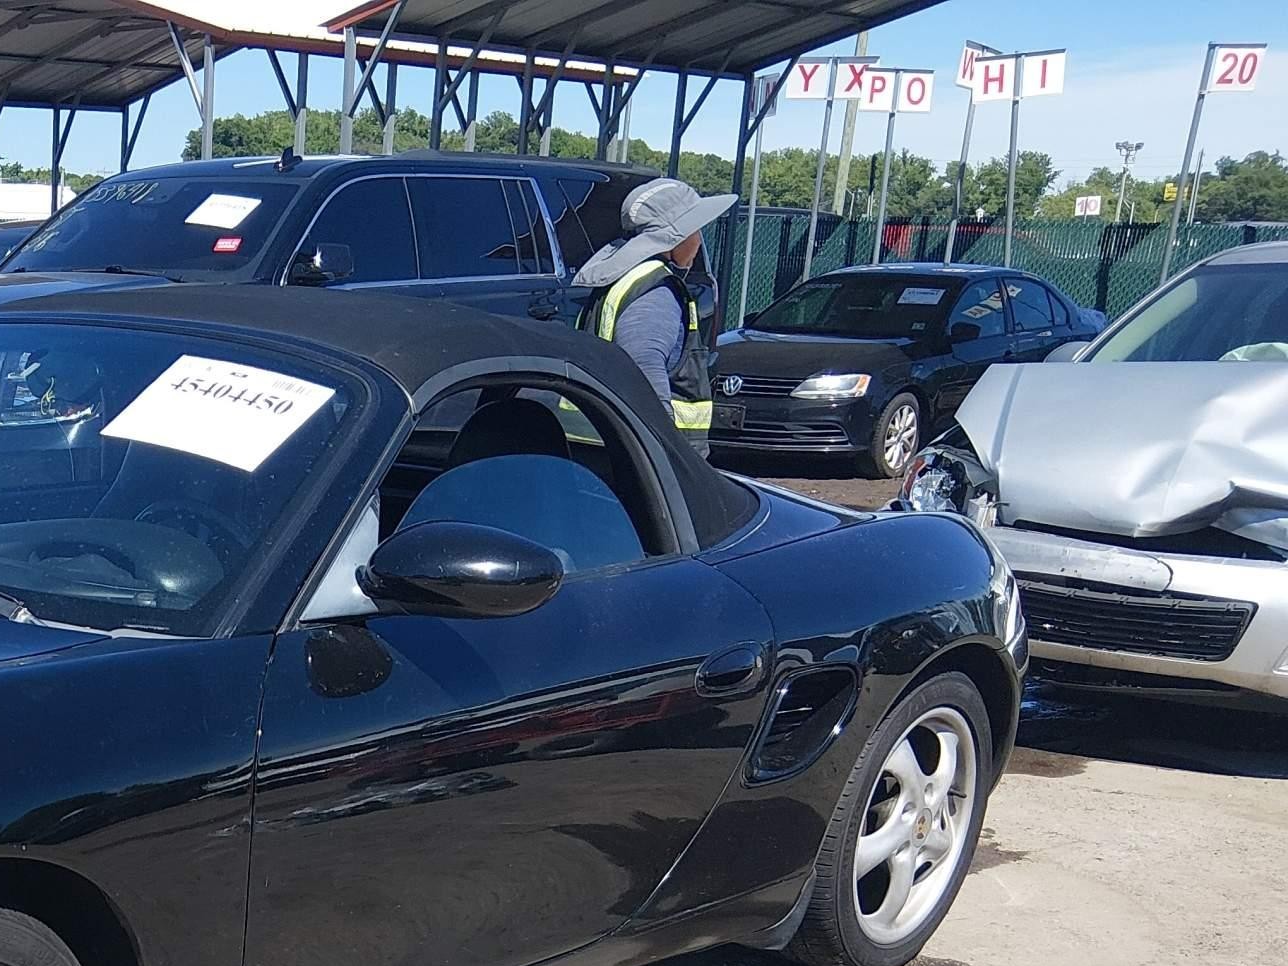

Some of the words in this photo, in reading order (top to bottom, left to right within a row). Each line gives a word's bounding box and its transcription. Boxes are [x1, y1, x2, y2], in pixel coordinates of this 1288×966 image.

[798, 64, 820, 92] Y
[844, 64, 869, 92] X
[983, 63, 1004, 94] H
[1040, 59, 1048, 88] I
[1216, 53, 1258, 84] 20
[869, 76, 886, 103] P
[1077, 199, 1098, 212] 10
[171, 376, 294, 415] 45404450
